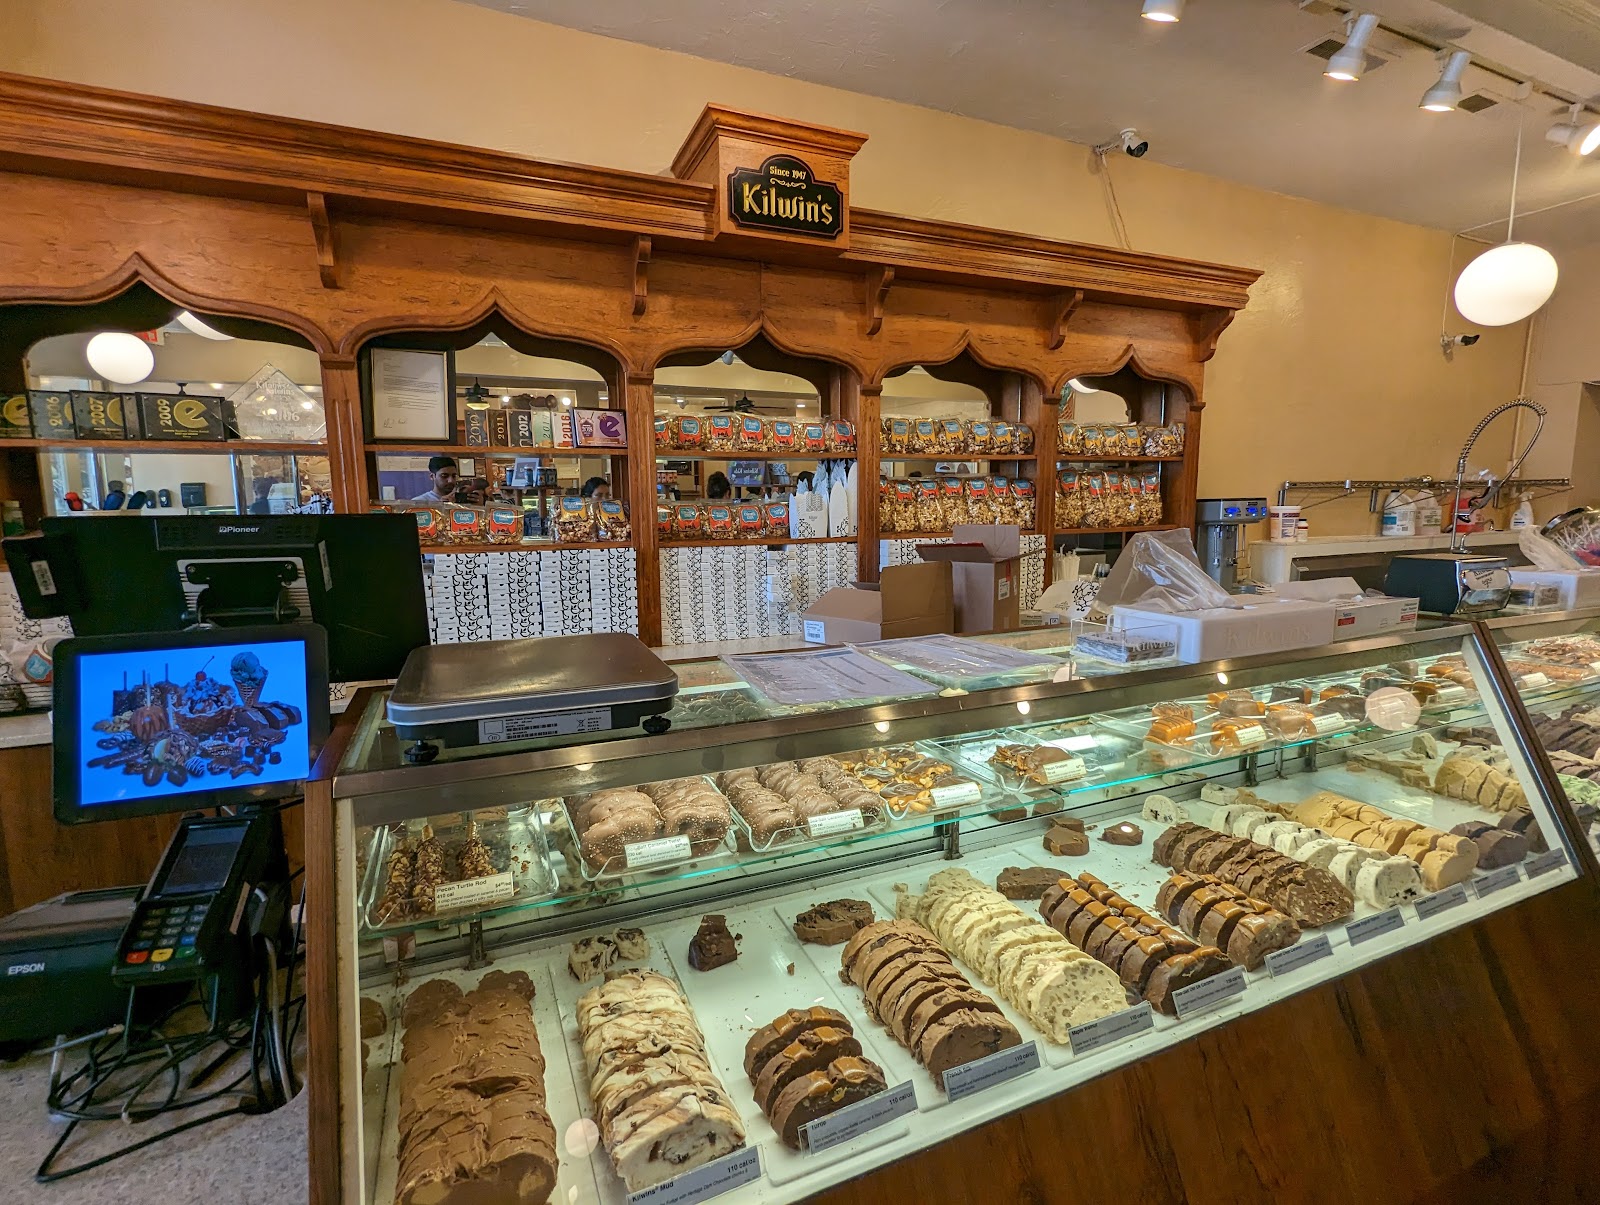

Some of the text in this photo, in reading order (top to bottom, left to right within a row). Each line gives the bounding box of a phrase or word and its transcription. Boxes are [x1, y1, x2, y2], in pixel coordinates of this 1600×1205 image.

[769, 165, 807, 180] Since 1947
[742, 181, 833, 225] Kilwin's
[88, 397, 105, 426] 2007
[157, 398, 172, 427] 2009
[469, 413, 482, 444] 2010
[496, 417, 505, 440] 2011
[518, 415, 529, 437] 2012
[561, 415, 572, 439] 2016
[436, 885, 456, 893] Pecan
[456, 881, 474, 890] Turtle
[8, 962, 46, 975] EPSON
[888, 1091, 914, 1105] 110 cal/oz
[726, 1157, 757, 1174] 110 cal/oz
[658, 1181, 675, 1192] Mud
